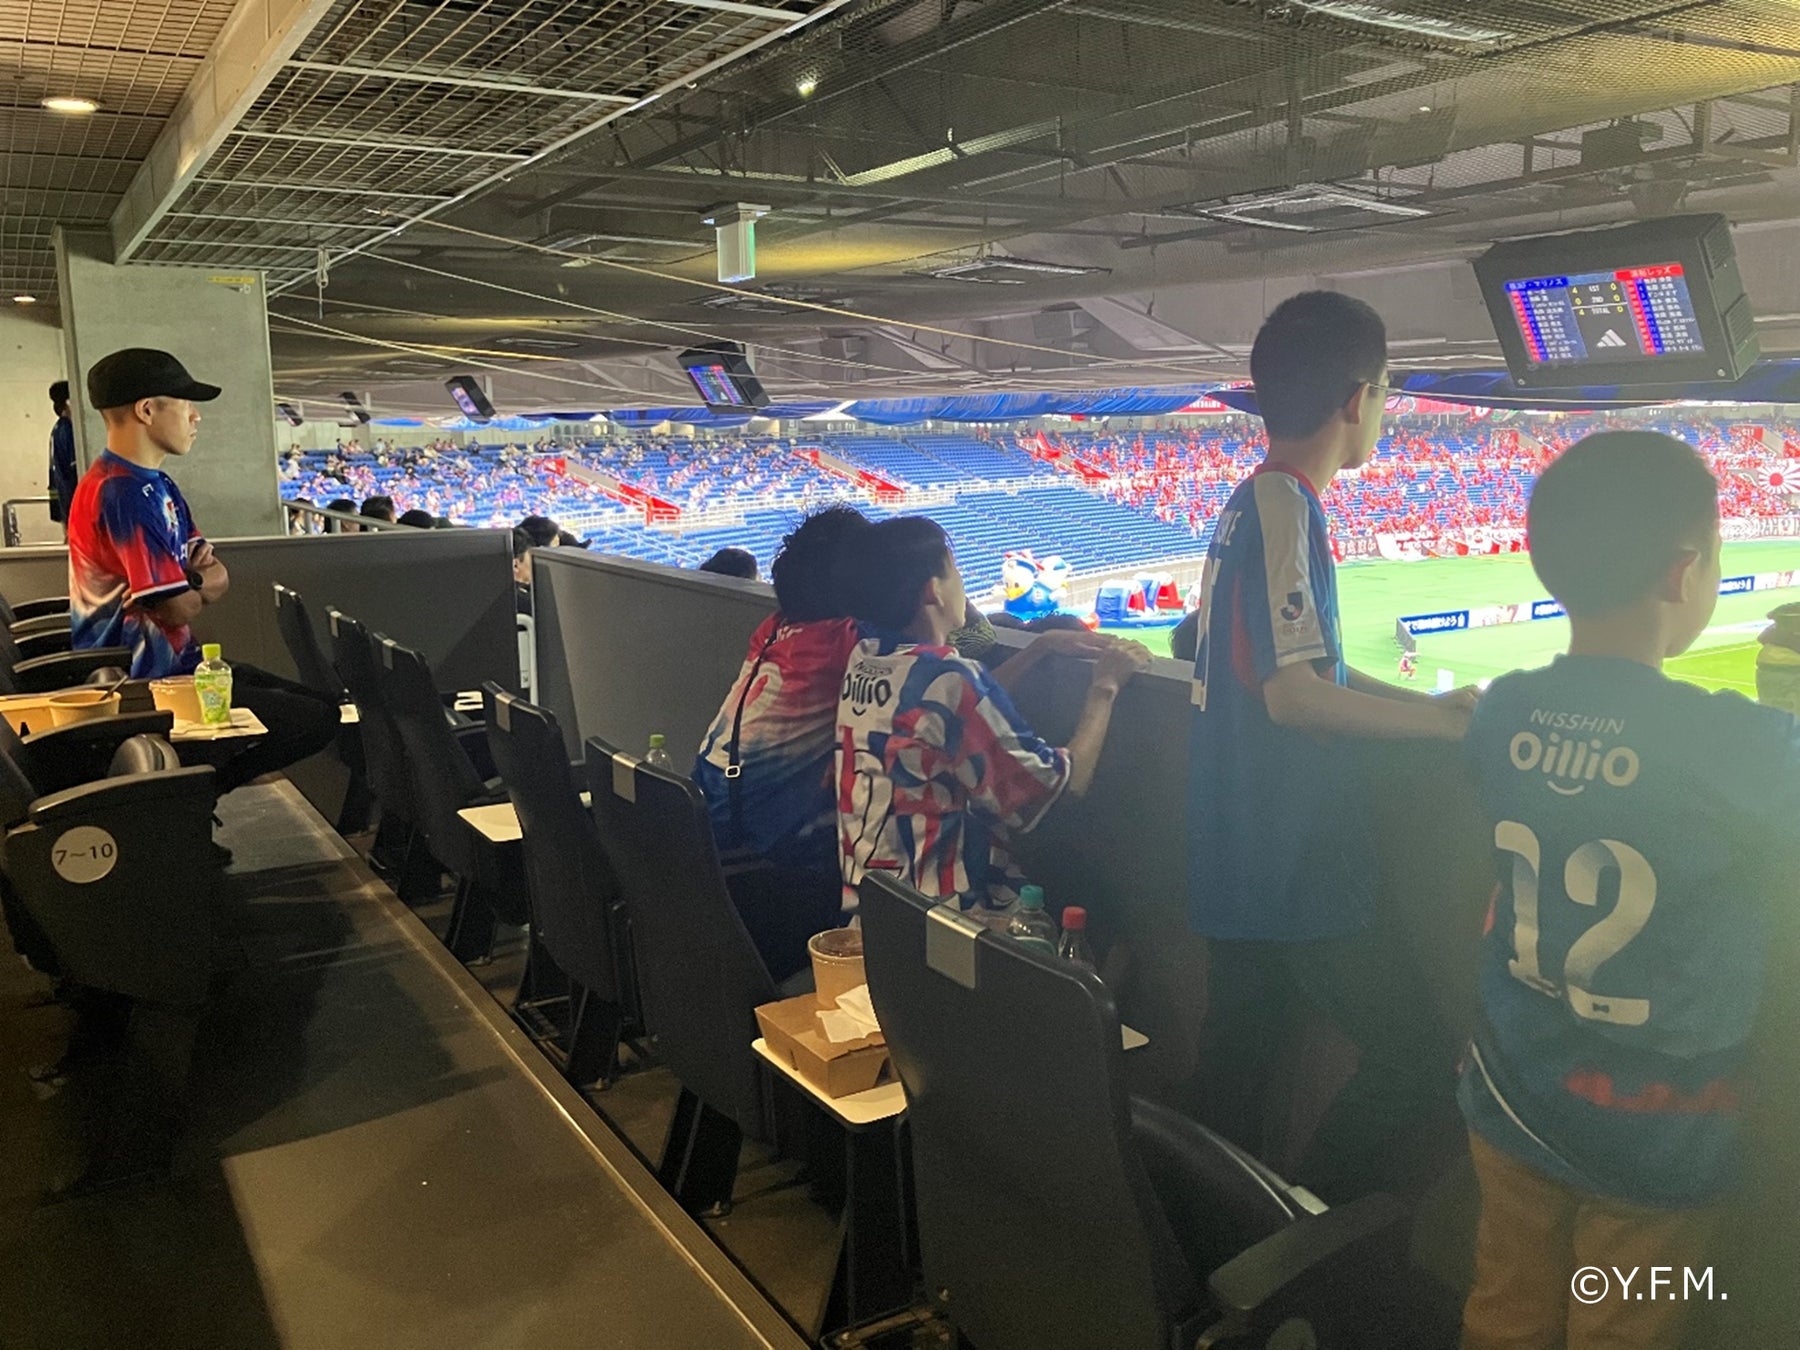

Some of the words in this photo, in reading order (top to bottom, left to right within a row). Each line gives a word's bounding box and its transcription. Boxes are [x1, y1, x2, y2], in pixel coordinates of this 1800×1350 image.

[1611, 282, 1618, 291] 0
[1575, 297, 1582, 305] 0
[1613, 294, 1620, 302] 0
[1617, 305, 1624, 313] 0
[1530, 708, 1625, 735] NISSHIN
[1494, 819, 1658, 1027] 12
